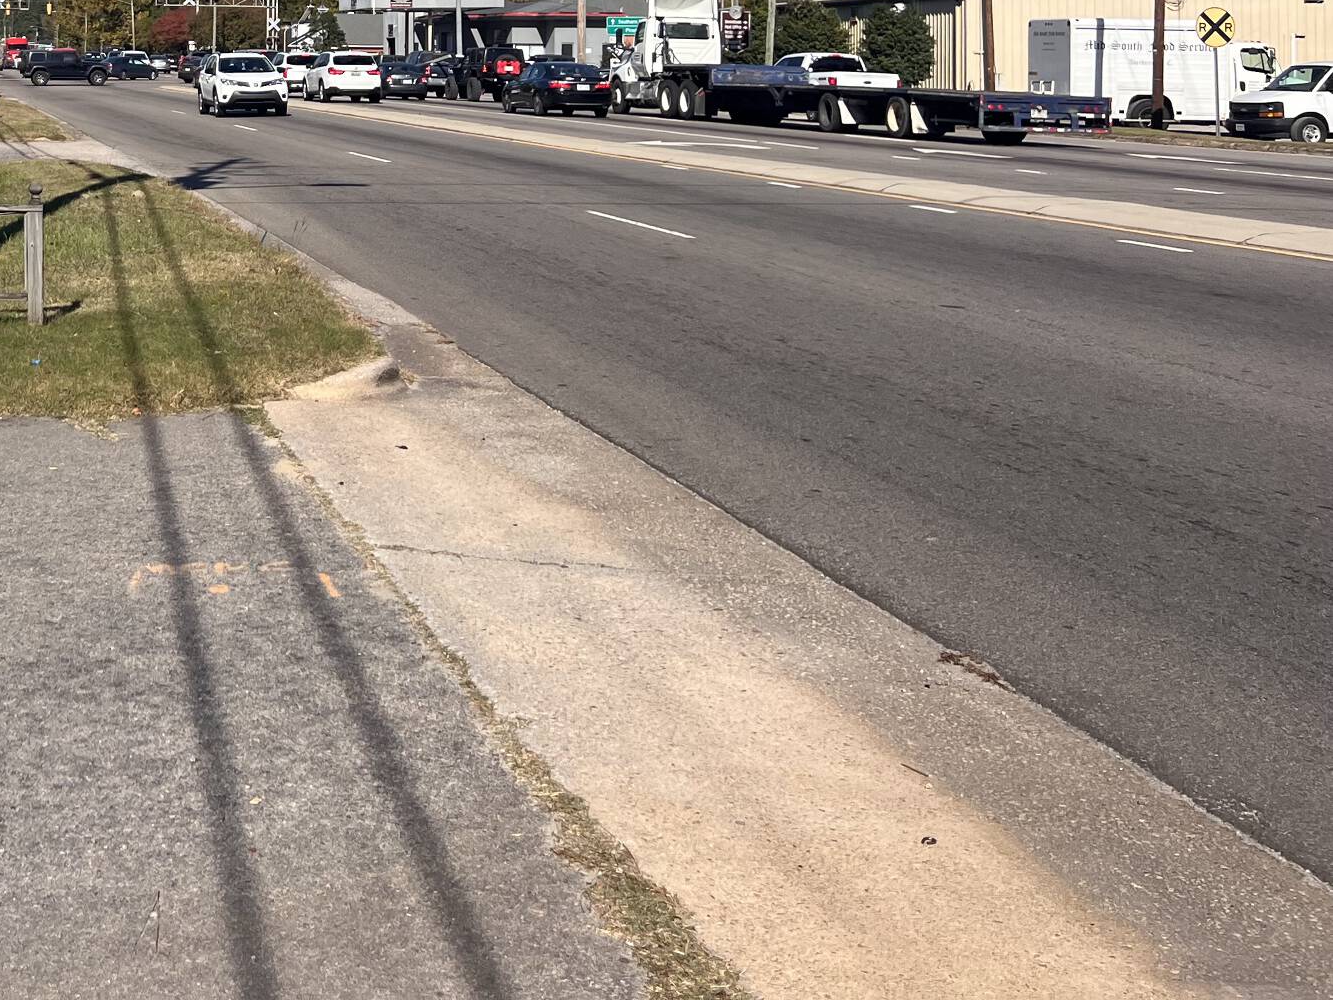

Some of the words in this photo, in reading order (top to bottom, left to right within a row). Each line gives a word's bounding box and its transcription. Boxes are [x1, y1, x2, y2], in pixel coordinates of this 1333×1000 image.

[1199, 22, 1207, 32] R
[1225, 22, 1233, 32] R
[1110, 40, 1143, 51] South
